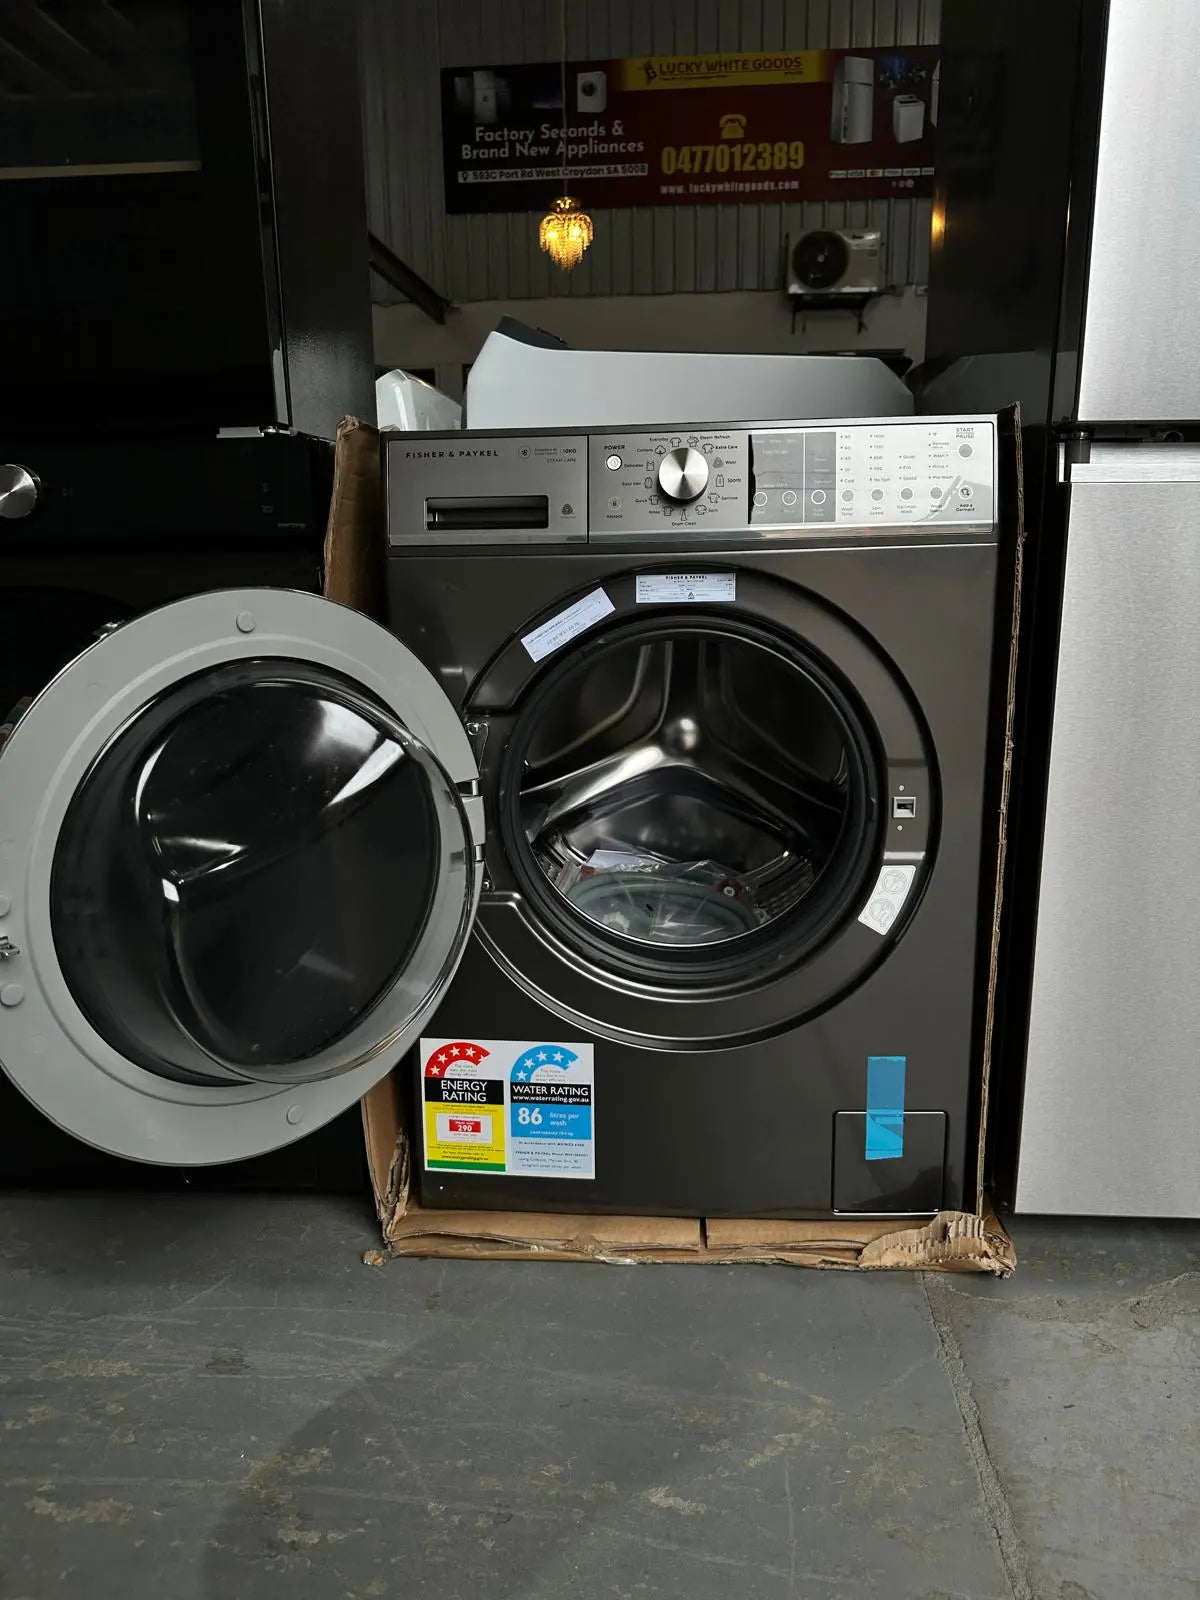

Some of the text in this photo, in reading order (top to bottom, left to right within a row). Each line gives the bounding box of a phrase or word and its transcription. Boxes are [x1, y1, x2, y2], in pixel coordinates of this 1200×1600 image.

[660, 57, 801, 74] LUCKY WHITE GOODS
[475, 119, 624, 144] Factory Seconds &
[461, 138, 644, 160] Brand New Appliances
[661, 141, 804, 175] 0477012389
[562, 166, 604, 179] Croydon
[606, 165, 620, 176] SA
[405, 451, 444, 459] FISHER
[459, 449, 499, 457] PAYKEL
[441, 1080, 488, 1091] ENERGY
[513, 1085, 588, 1096] WATER RATING
[442, 1091, 487, 1102] RATING
[513, 1095, 589, 1103] www.waterrating.gov.au
[518, 1107, 543, 1125] 86
[457, 1124, 473, 1132] 290
